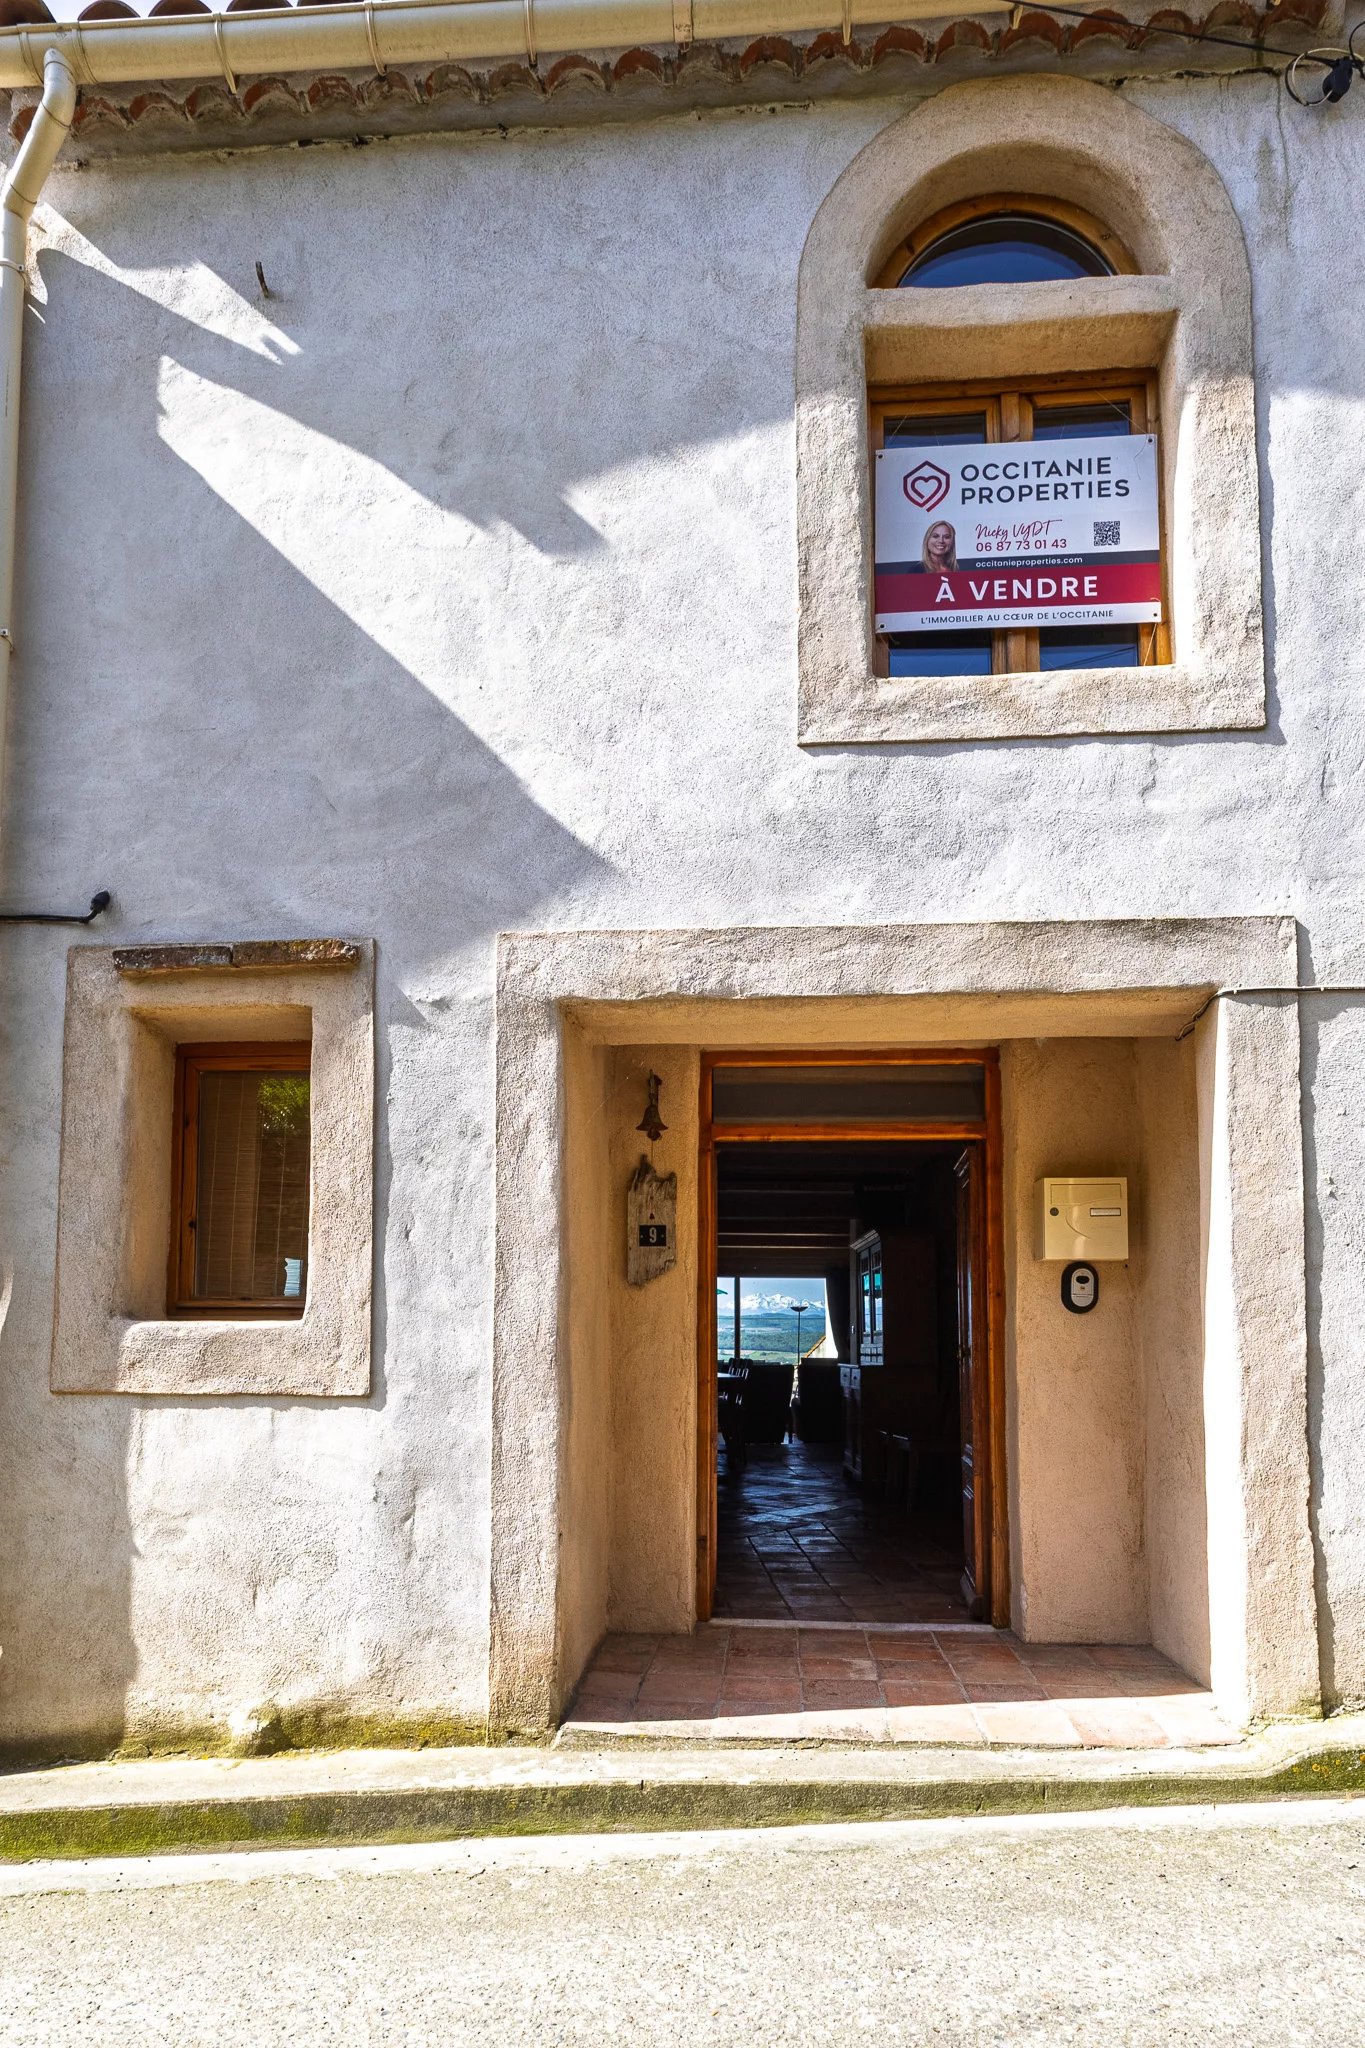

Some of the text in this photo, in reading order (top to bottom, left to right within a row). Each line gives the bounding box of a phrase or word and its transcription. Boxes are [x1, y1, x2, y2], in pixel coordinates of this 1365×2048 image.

[961, 457, 1111, 481] OCCITANIE
[961, 479, 1130, 504] PROPERTIES
[975, 523, 1008, 541] Nicky
[976, 538, 1067, 552] 06 87 73 01 43
[976, 556, 1082, 568] occitanieproperties.com
[936, 576, 1098, 602] À VENDRE
[921, 610, 1113, 624] L’IMMOBILIER AU CŒUR DE L’OCCITANIE
[649, 1227, 657, 1243] 9
